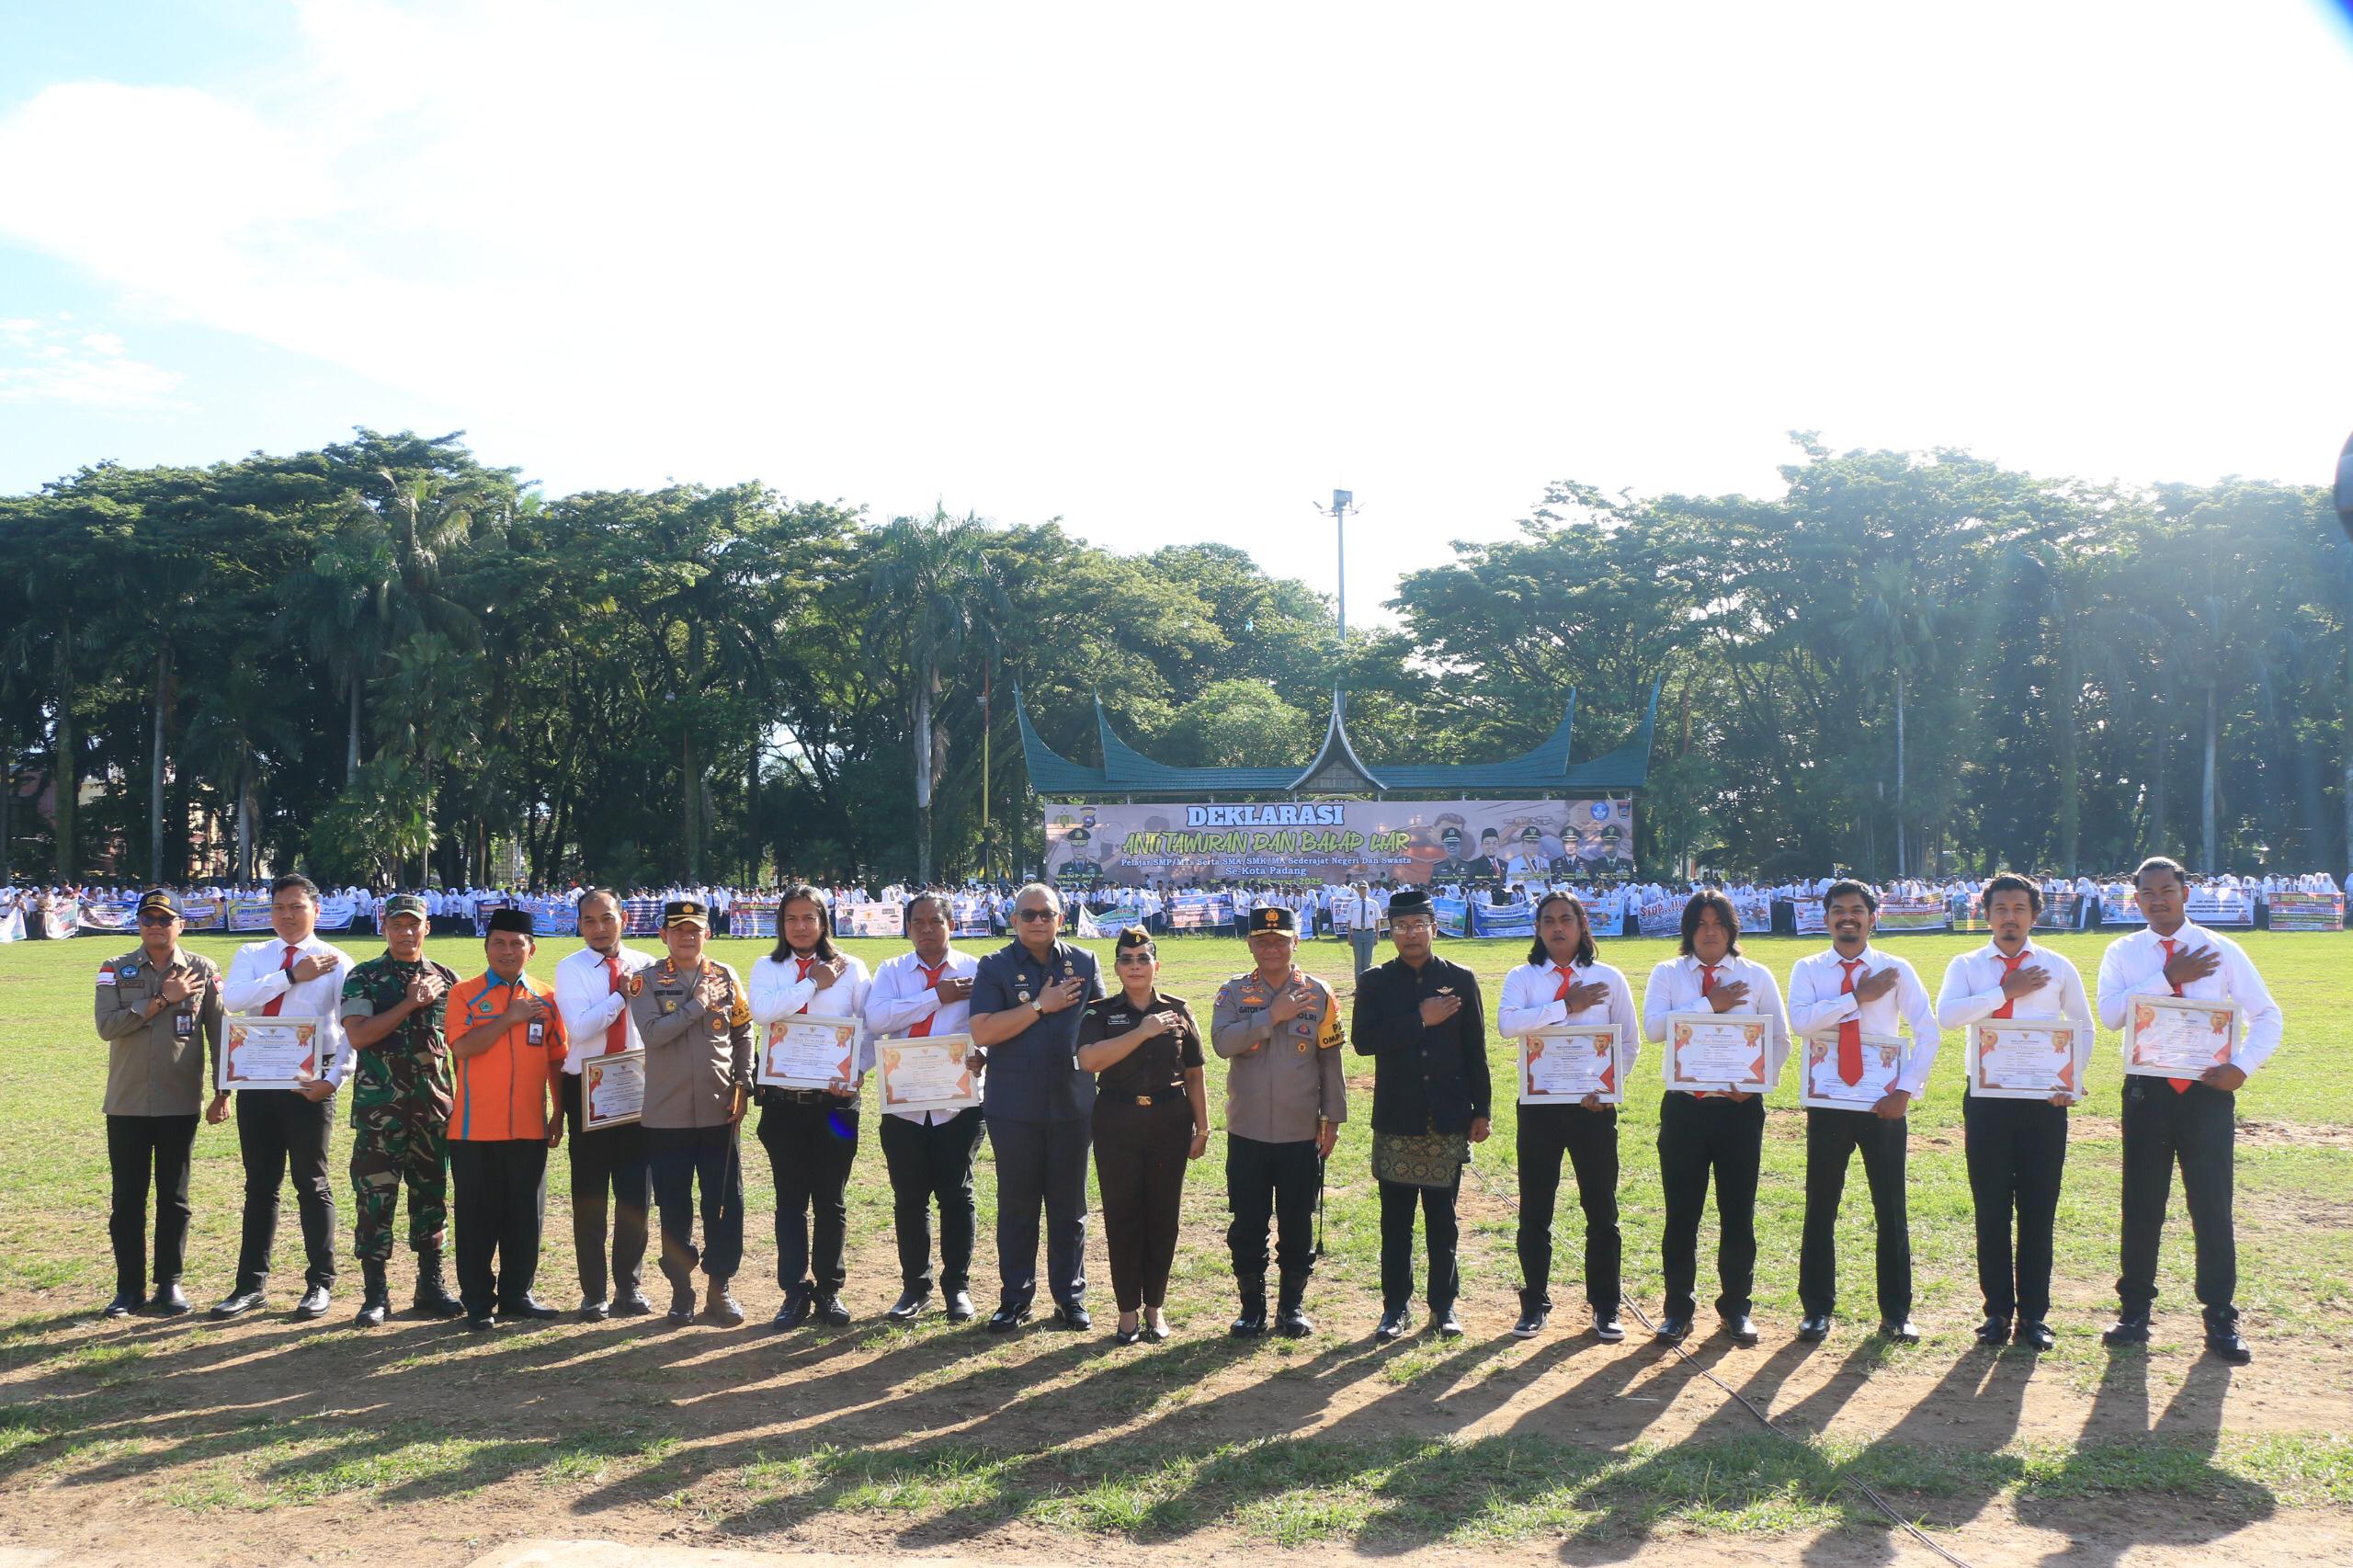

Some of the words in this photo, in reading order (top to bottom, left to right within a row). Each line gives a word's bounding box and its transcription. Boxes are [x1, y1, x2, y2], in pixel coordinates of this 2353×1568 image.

[1187, 804, 1345, 826] DEKLARASI
[1162, 831, 1249, 855] TAWURAN
[1253, 830, 1297, 853] DAN
[1301, 830, 1364, 853] BALAP
[1370, 831, 1411, 853] LIAR
[1121, 858, 1150, 868] Pelajar
[1222, 857, 1286, 866] SMA/SMK/MA
[1288, 857, 1329, 866] Sederajat
[1332, 857, 1359, 866] Negeri
[1225, 867, 1266, 875] Se-Kota
[1269, 867, 1307, 876] Padang
[1296, 1012, 1317, 1021] OLRI
